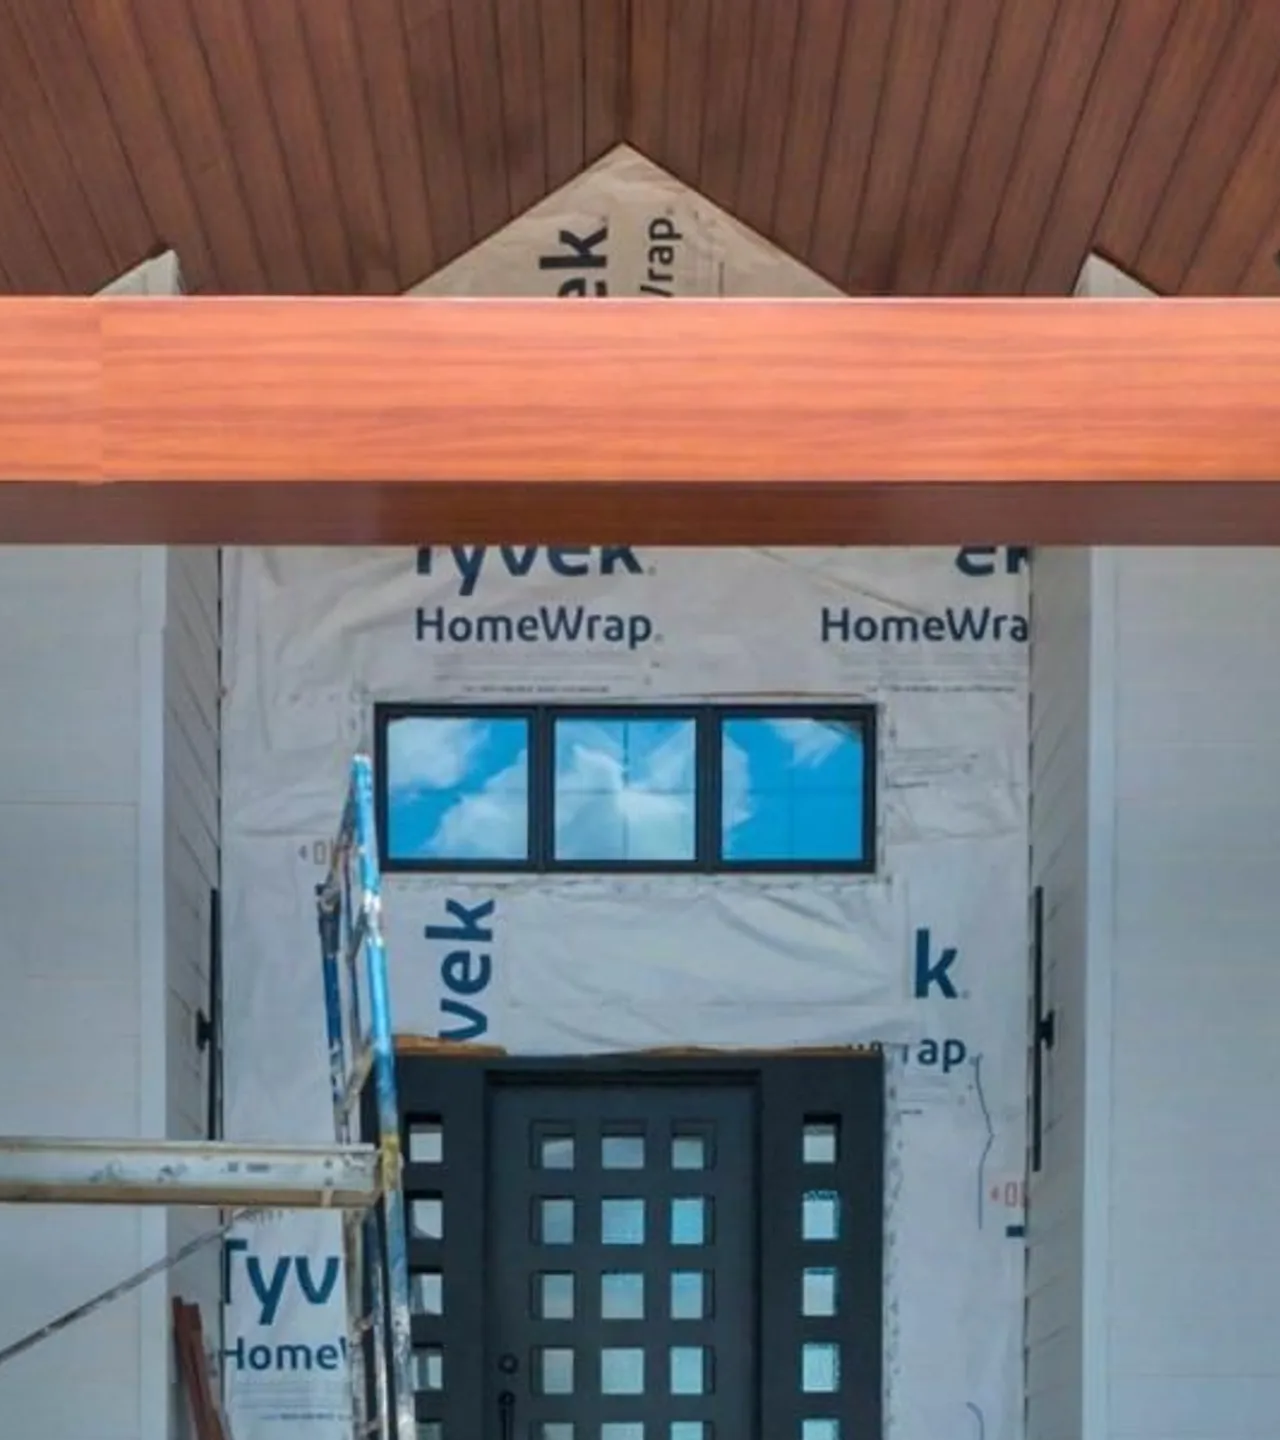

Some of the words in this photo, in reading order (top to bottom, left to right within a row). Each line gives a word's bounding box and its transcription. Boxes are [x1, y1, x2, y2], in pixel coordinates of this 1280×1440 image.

[416, 606, 653, 649] HomeWrap
[822, 607, 1028, 643] HomeWra
[425, 898, 495, 1040] vek
[915, 928, 958, 999] k
[224, 1337, 346, 1370] Home
